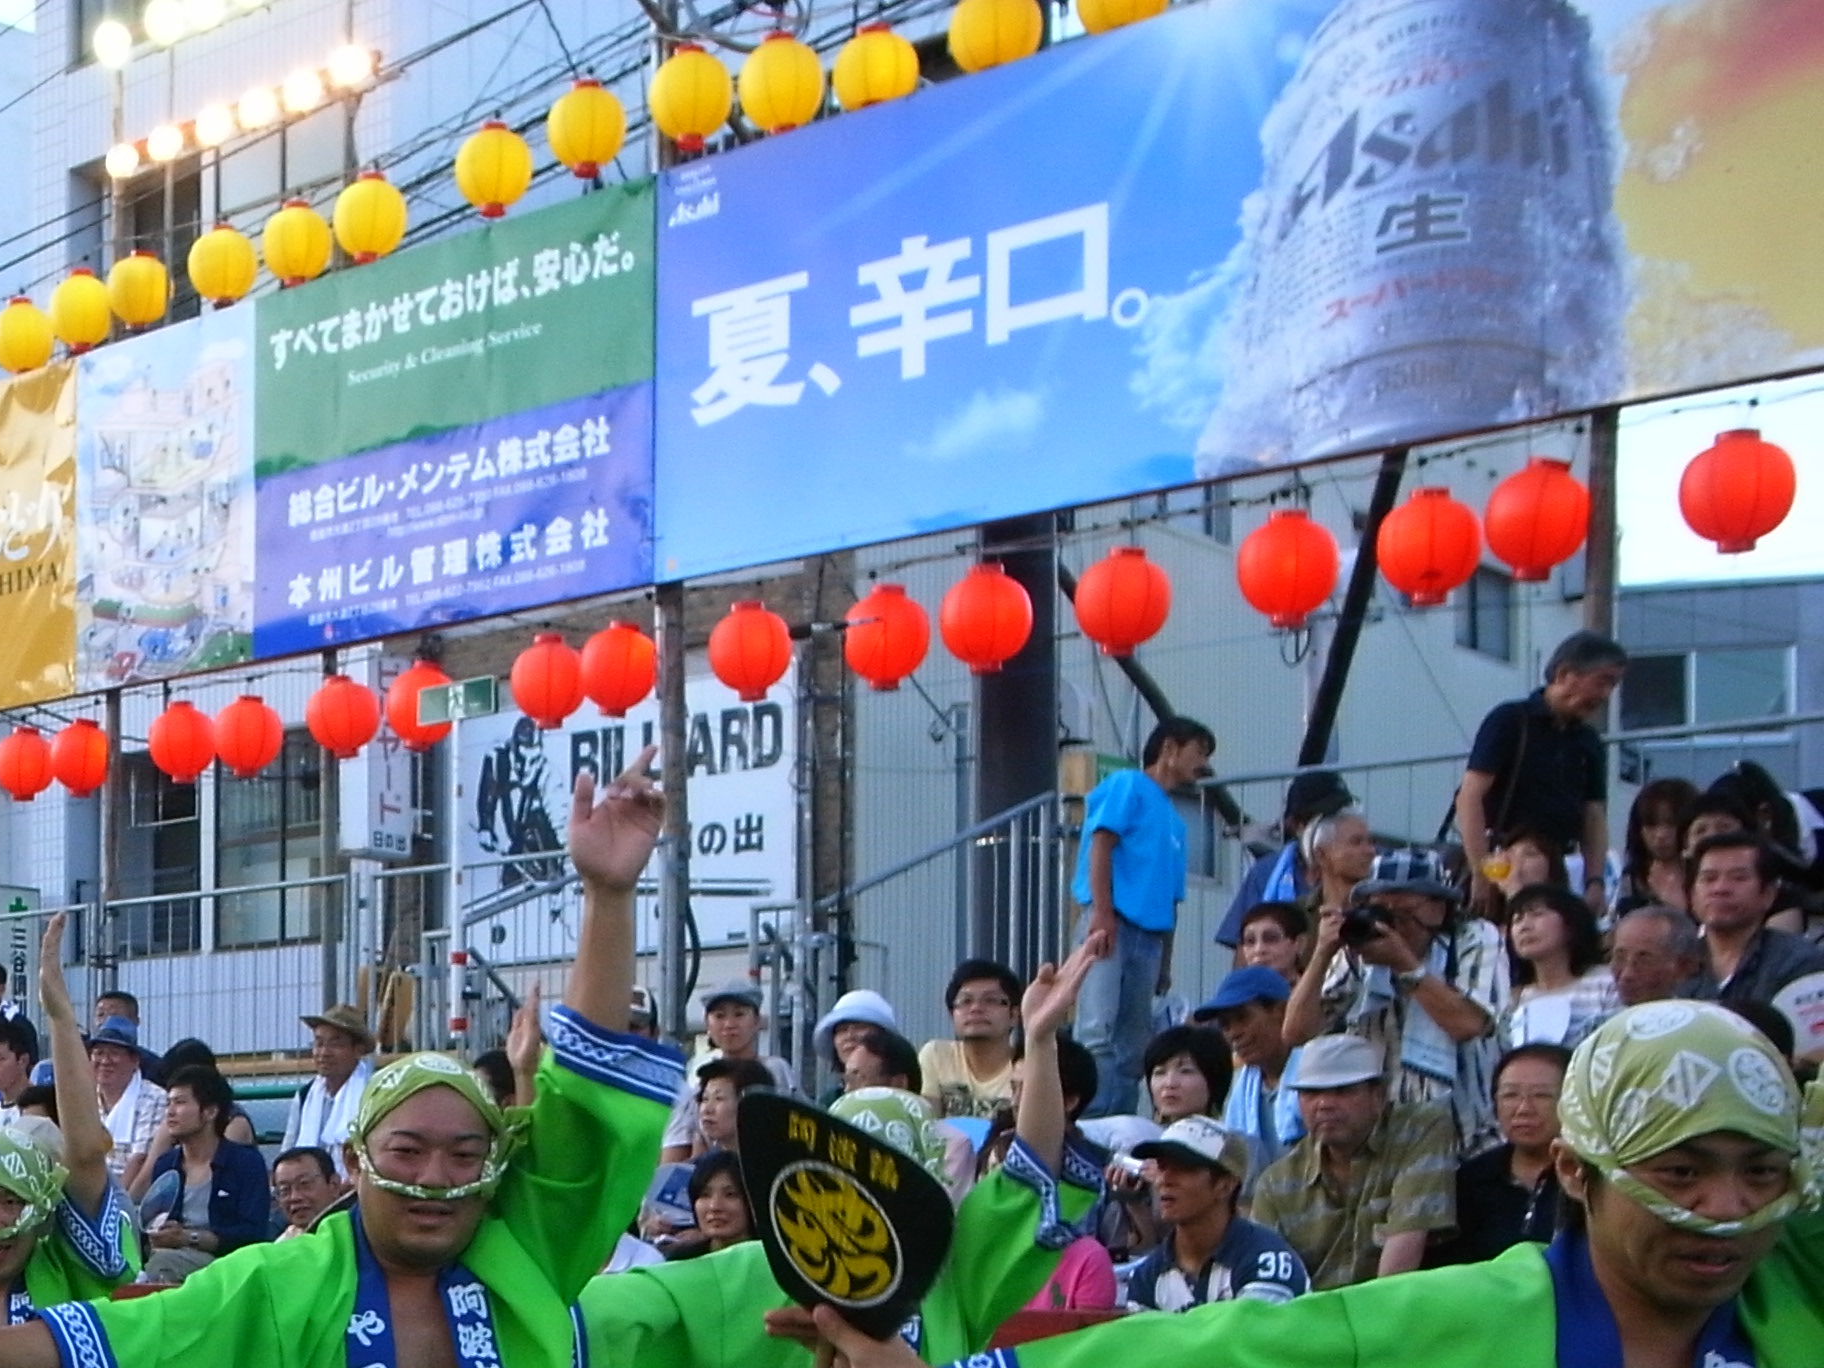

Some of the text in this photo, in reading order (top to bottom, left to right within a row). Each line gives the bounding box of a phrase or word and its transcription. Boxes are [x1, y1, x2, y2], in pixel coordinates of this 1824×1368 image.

[1375, 193, 1472, 255] 生
[270, 230, 634, 371] すべてまかせておけば、安心だ。
[691, 202, 1149, 427] 夏、辛口。
[347, 322, 544, 386] Security & Cleaning Service
[377, 660, 401, 825] ビヤード
[687, 813, 764, 860] の出
[1257, 1250, 1293, 1280] 36
